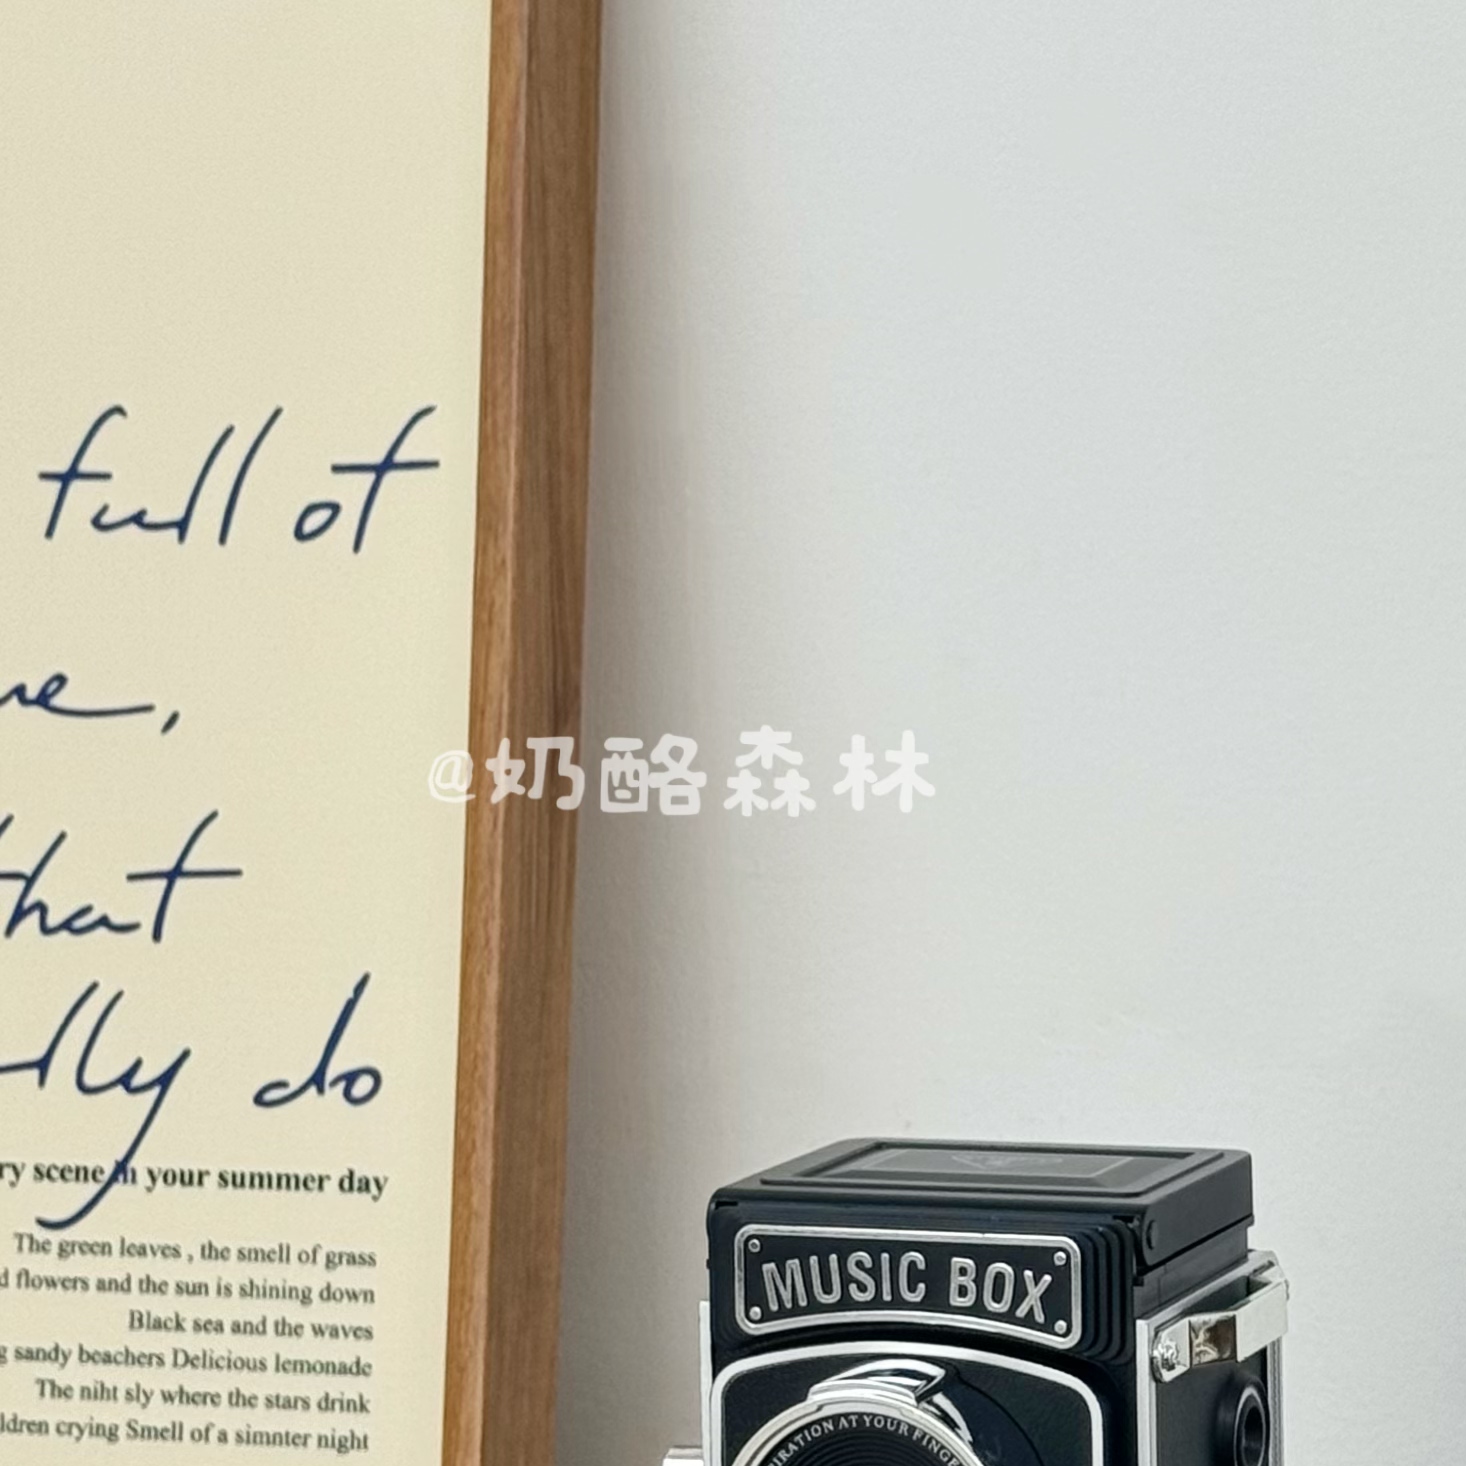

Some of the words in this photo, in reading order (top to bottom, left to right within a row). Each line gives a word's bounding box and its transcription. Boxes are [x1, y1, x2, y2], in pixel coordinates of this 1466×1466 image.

[38, 404, 283, 546] full
[294, 405, 441, 554] of
[253, 972, 383, 1108] do
[33, 1160, 105, 1184] scene
[145, 1165, 210, 1193] your
[217, 1169, 331, 1193] summer
[338, 1168, 389, 1203] day
[14, 1232, 51, 1254] The
[57, 1238, 113, 1261] green
[200, 1239, 231, 1261] the
[237, 1242, 290, 1265] smell
[297, 1243, 322, 1265] of
[325, 1250, 377, 1271] grass
[16, 1268, 89, 1291] flowers
[95, 1272, 131, 1294] and
[138, 1274, 168, 1295] the
[175, 1280, 209, 1297] sun
[216, 1276, 233, 1298] is
[239, 1277, 313, 1306] shining
[318, 1281, 376, 1304] down
[761, 1251, 926, 1312] MUSIC
[949, 1256, 1052, 1323] BOX
[128, 1309, 187, 1332] Black
[192, 1317, 224, 1334] sea
[230, 1315, 267, 1336] and
[274, 1316, 304, 1337] the
[311, 1322, 374, 1340] waves
[14, 1341, 72, 1369] sandy
[78, 1343, 165, 1367] beachers
[172, 1347, 268, 1373] Delicious
[274, 1352, 373, 1377] lemonade
[35, 1378, 74, 1400] The
[80, 1379, 118, 1402] niht
[125, 1382, 154, 1409] sly
[160, 1385, 222, 1408] where
[228, 1387, 259, 1409] the
[264, 1392, 311, 1411] stars
[317, 1391, 371, 1414] drink
[56, 1415, 119, 1444] crying
[126, 1418, 184, 1442] Smell
[190, 1421, 216, 1443] of
[217, 1428, 229, 1444] a
[317, 1428, 369, 1454] night
[838, 1414, 859, 1431] AT
[863, 1414, 910, 1436] YOUR
